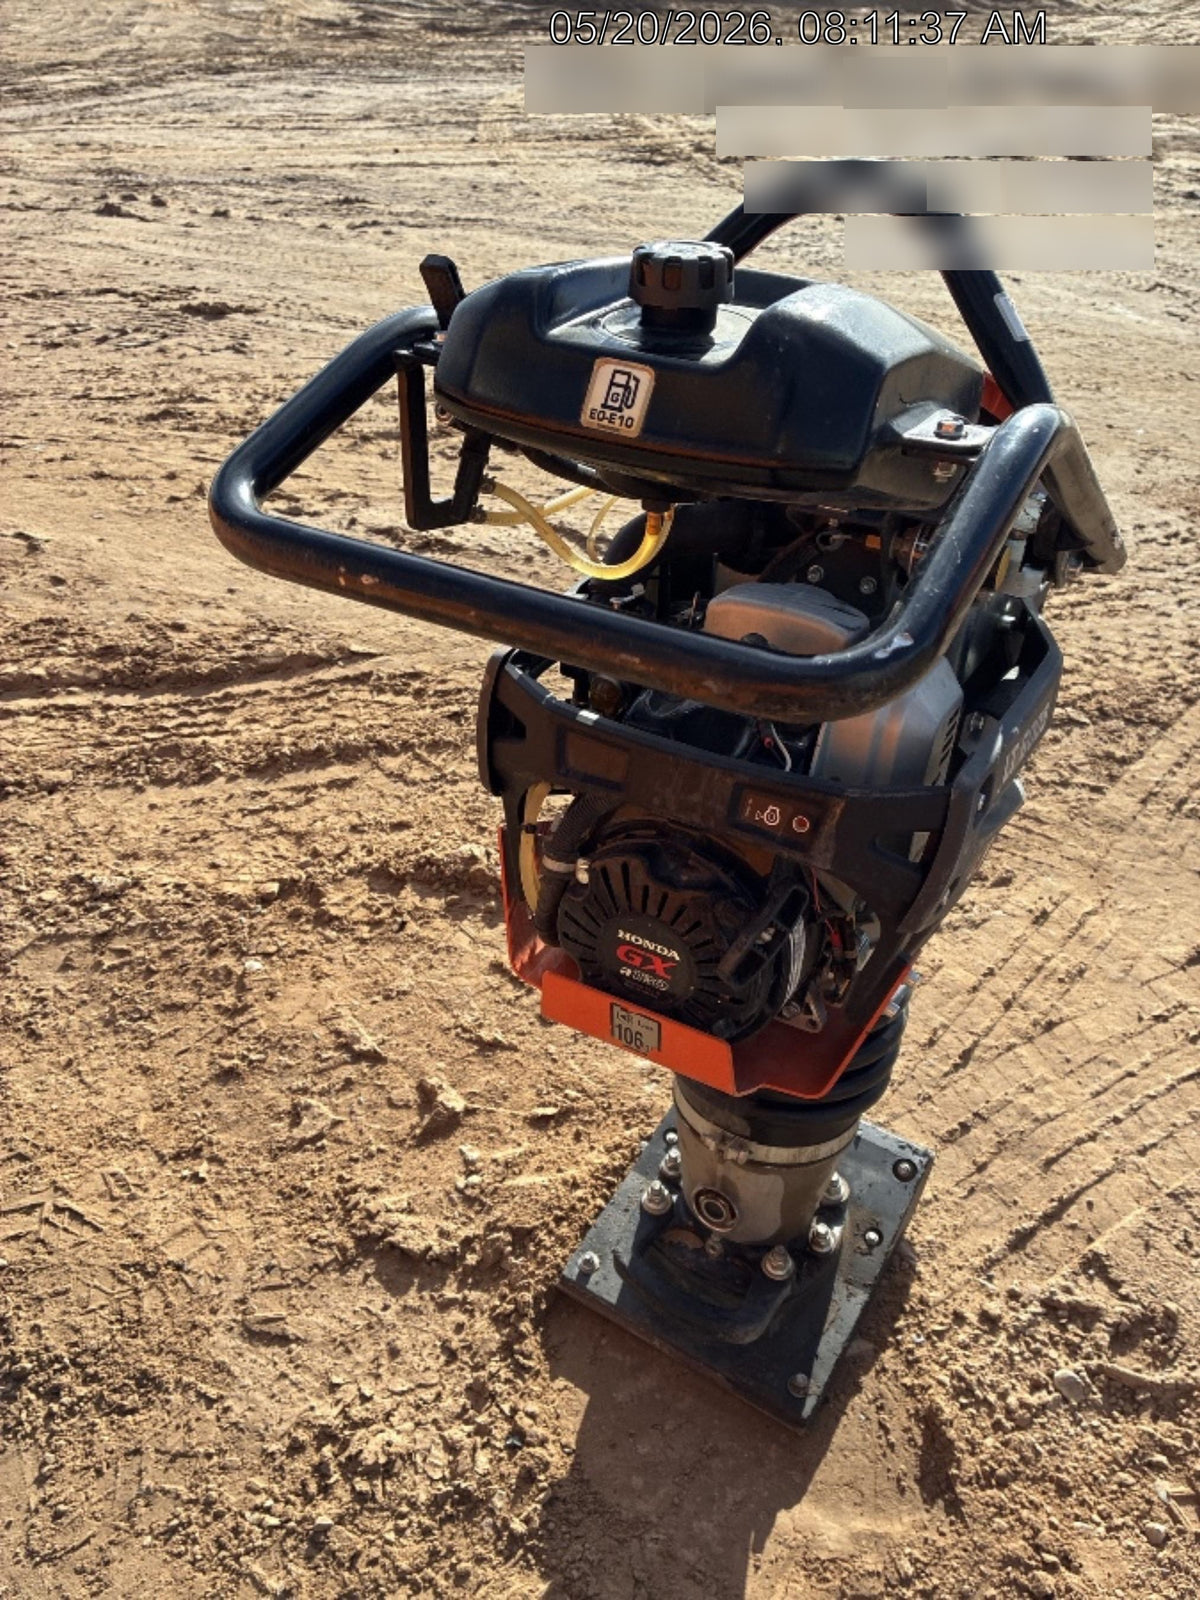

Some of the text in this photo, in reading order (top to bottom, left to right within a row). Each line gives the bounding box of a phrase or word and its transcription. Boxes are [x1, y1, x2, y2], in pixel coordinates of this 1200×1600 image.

[617, 929, 680, 961] HONDA
[616, 944, 678, 981] GX
[615, 1023, 644, 1050] 106
